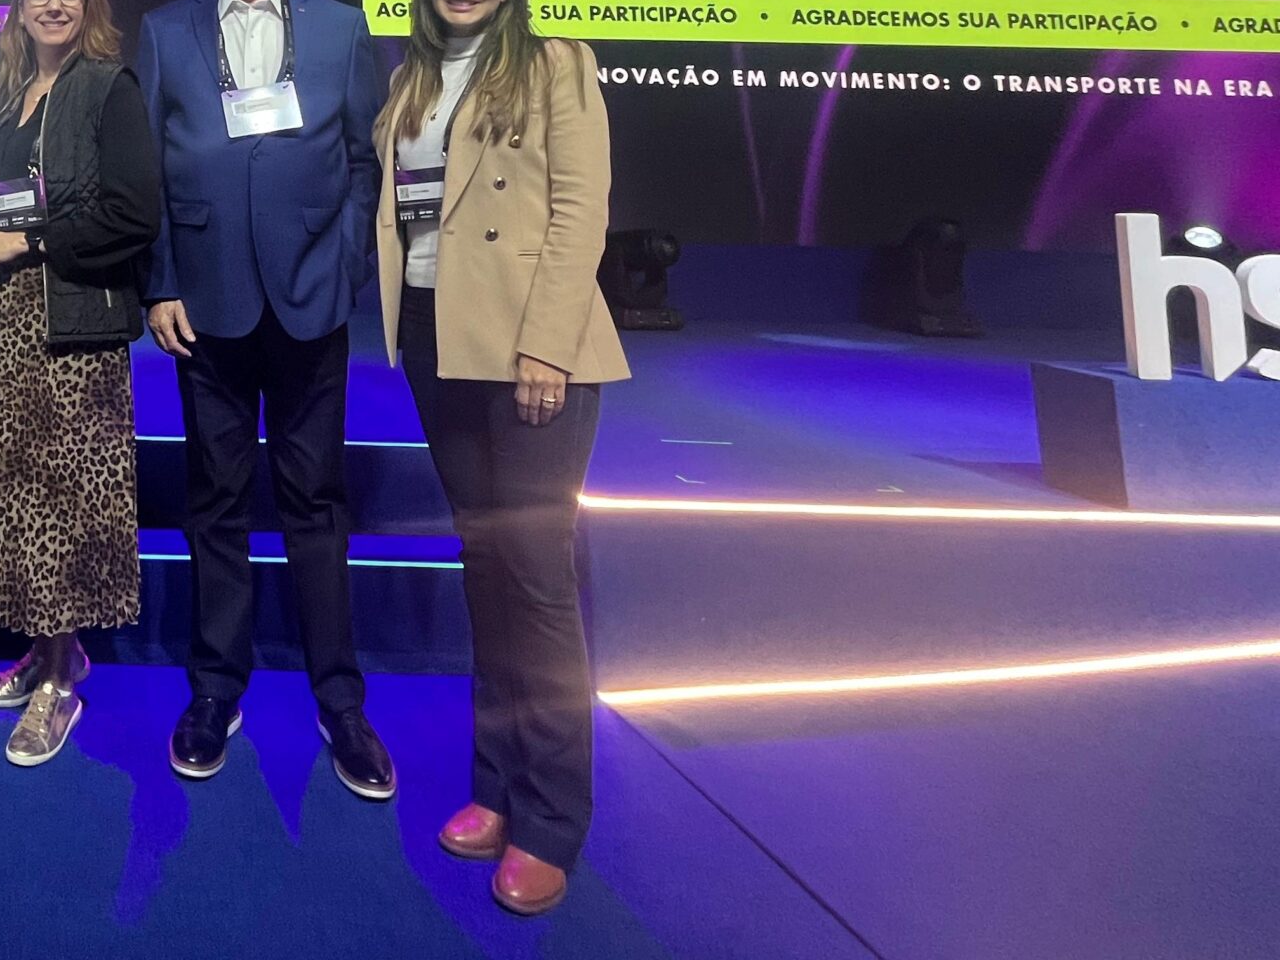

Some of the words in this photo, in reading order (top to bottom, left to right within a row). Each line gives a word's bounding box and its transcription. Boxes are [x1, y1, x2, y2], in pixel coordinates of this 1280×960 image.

[540, 5, 583, 21] SUA
[589, 2, 737, 27] PARTICIPAÇÃO
[792, 9, 950, 28] AGRADECEMOS
[958, 12, 1000, 29] SUA
[1007, 11, 1157, 34] PARTICIPAÇÃO
[732, 69, 767, 87] EM
[779, 70, 951, 91] MOVIMENTO:
[962, 74, 981, 91] O
[993, 74, 1161, 95] TRANSPORTE
[1173, 78, 1213, 96] NA
[1223, 79, 1274, 97] ERA
